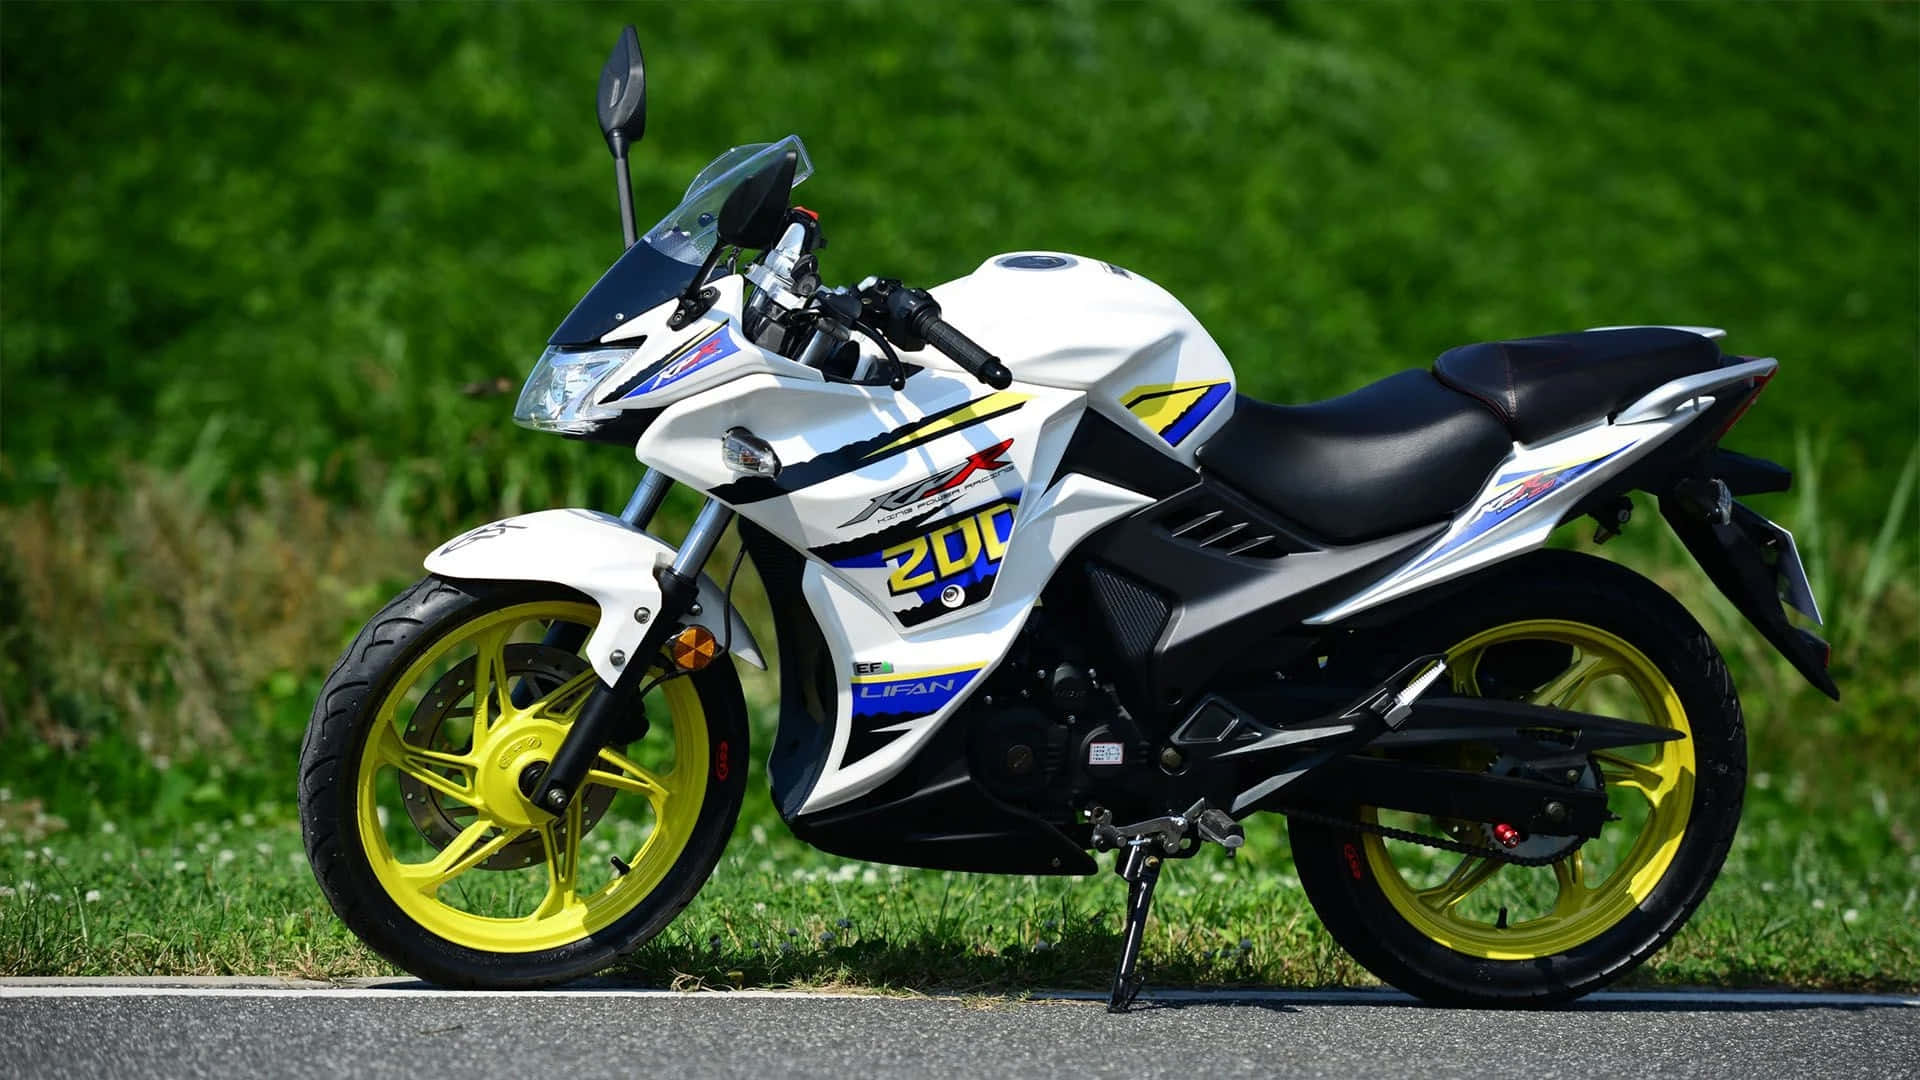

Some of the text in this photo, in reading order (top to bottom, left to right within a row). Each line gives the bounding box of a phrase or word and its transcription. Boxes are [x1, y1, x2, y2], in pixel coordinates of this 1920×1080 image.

[837, 438, 1014, 529] KPR
[876, 465, 1015, 525] KING POWER RACING
[882, 503, 1017, 593] 200
[860, 679, 955, 699] LIFAN
